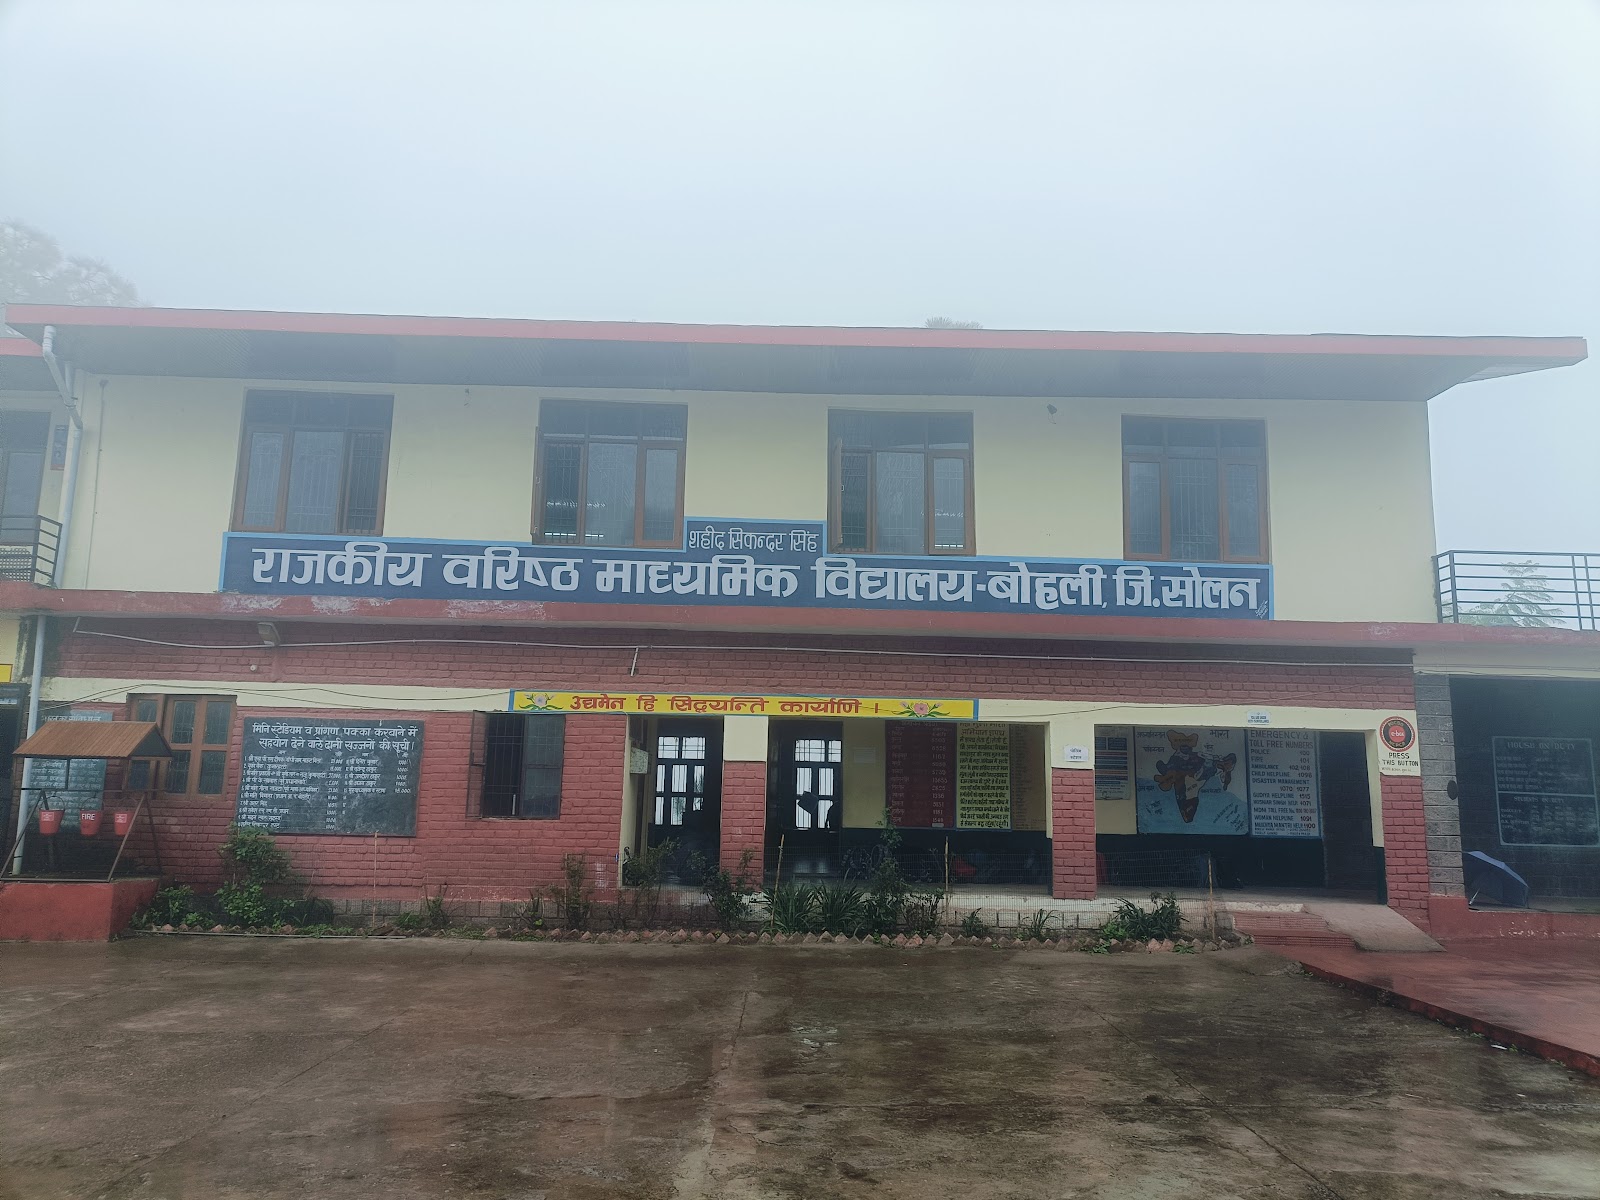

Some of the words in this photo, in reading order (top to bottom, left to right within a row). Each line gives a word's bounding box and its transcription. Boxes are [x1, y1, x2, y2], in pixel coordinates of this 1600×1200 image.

[688, 525, 726, 550] शहीद
[728, 527, 787, 553] सिकन्दर
[789, 529, 820, 553] सिंह
[251, 541, 433, 587] राजकीय
[441, 546, 584, 592] वरिष्ठ
[591, 554, 801, 598] माध्यमिक
[636, 695, 658, 711] हि
[778, 697, 862, 714] कार्याणि
[252, 722, 271, 733] मिनि
[271, 722, 303, 736] स्टेडियम
[304, 726, 313, 735] व
[342, 727, 372, 736] पक्का
[374, 725, 406, 738] करवाने
[407, 725, 419, 737] में
[1210, 729, 1230, 739] भारत
[1250, 730, 1301, 740] EMERGENCY
[259, 736, 289, 749] सहयोग
[291, 737, 305, 750] देने
[307, 737, 324, 750] वाले
[325, 738, 343, 751] दानी
[379, 738, 391, 750] की
[1249, 740, 1265, 748] TOLL
[1285, 741, 1314, 749] NUMBERS
[1539, 742, 1550, 750] ON
[1389, 752, 1410, 760] PRESS
[81, 813, 96, 821] FIRE
